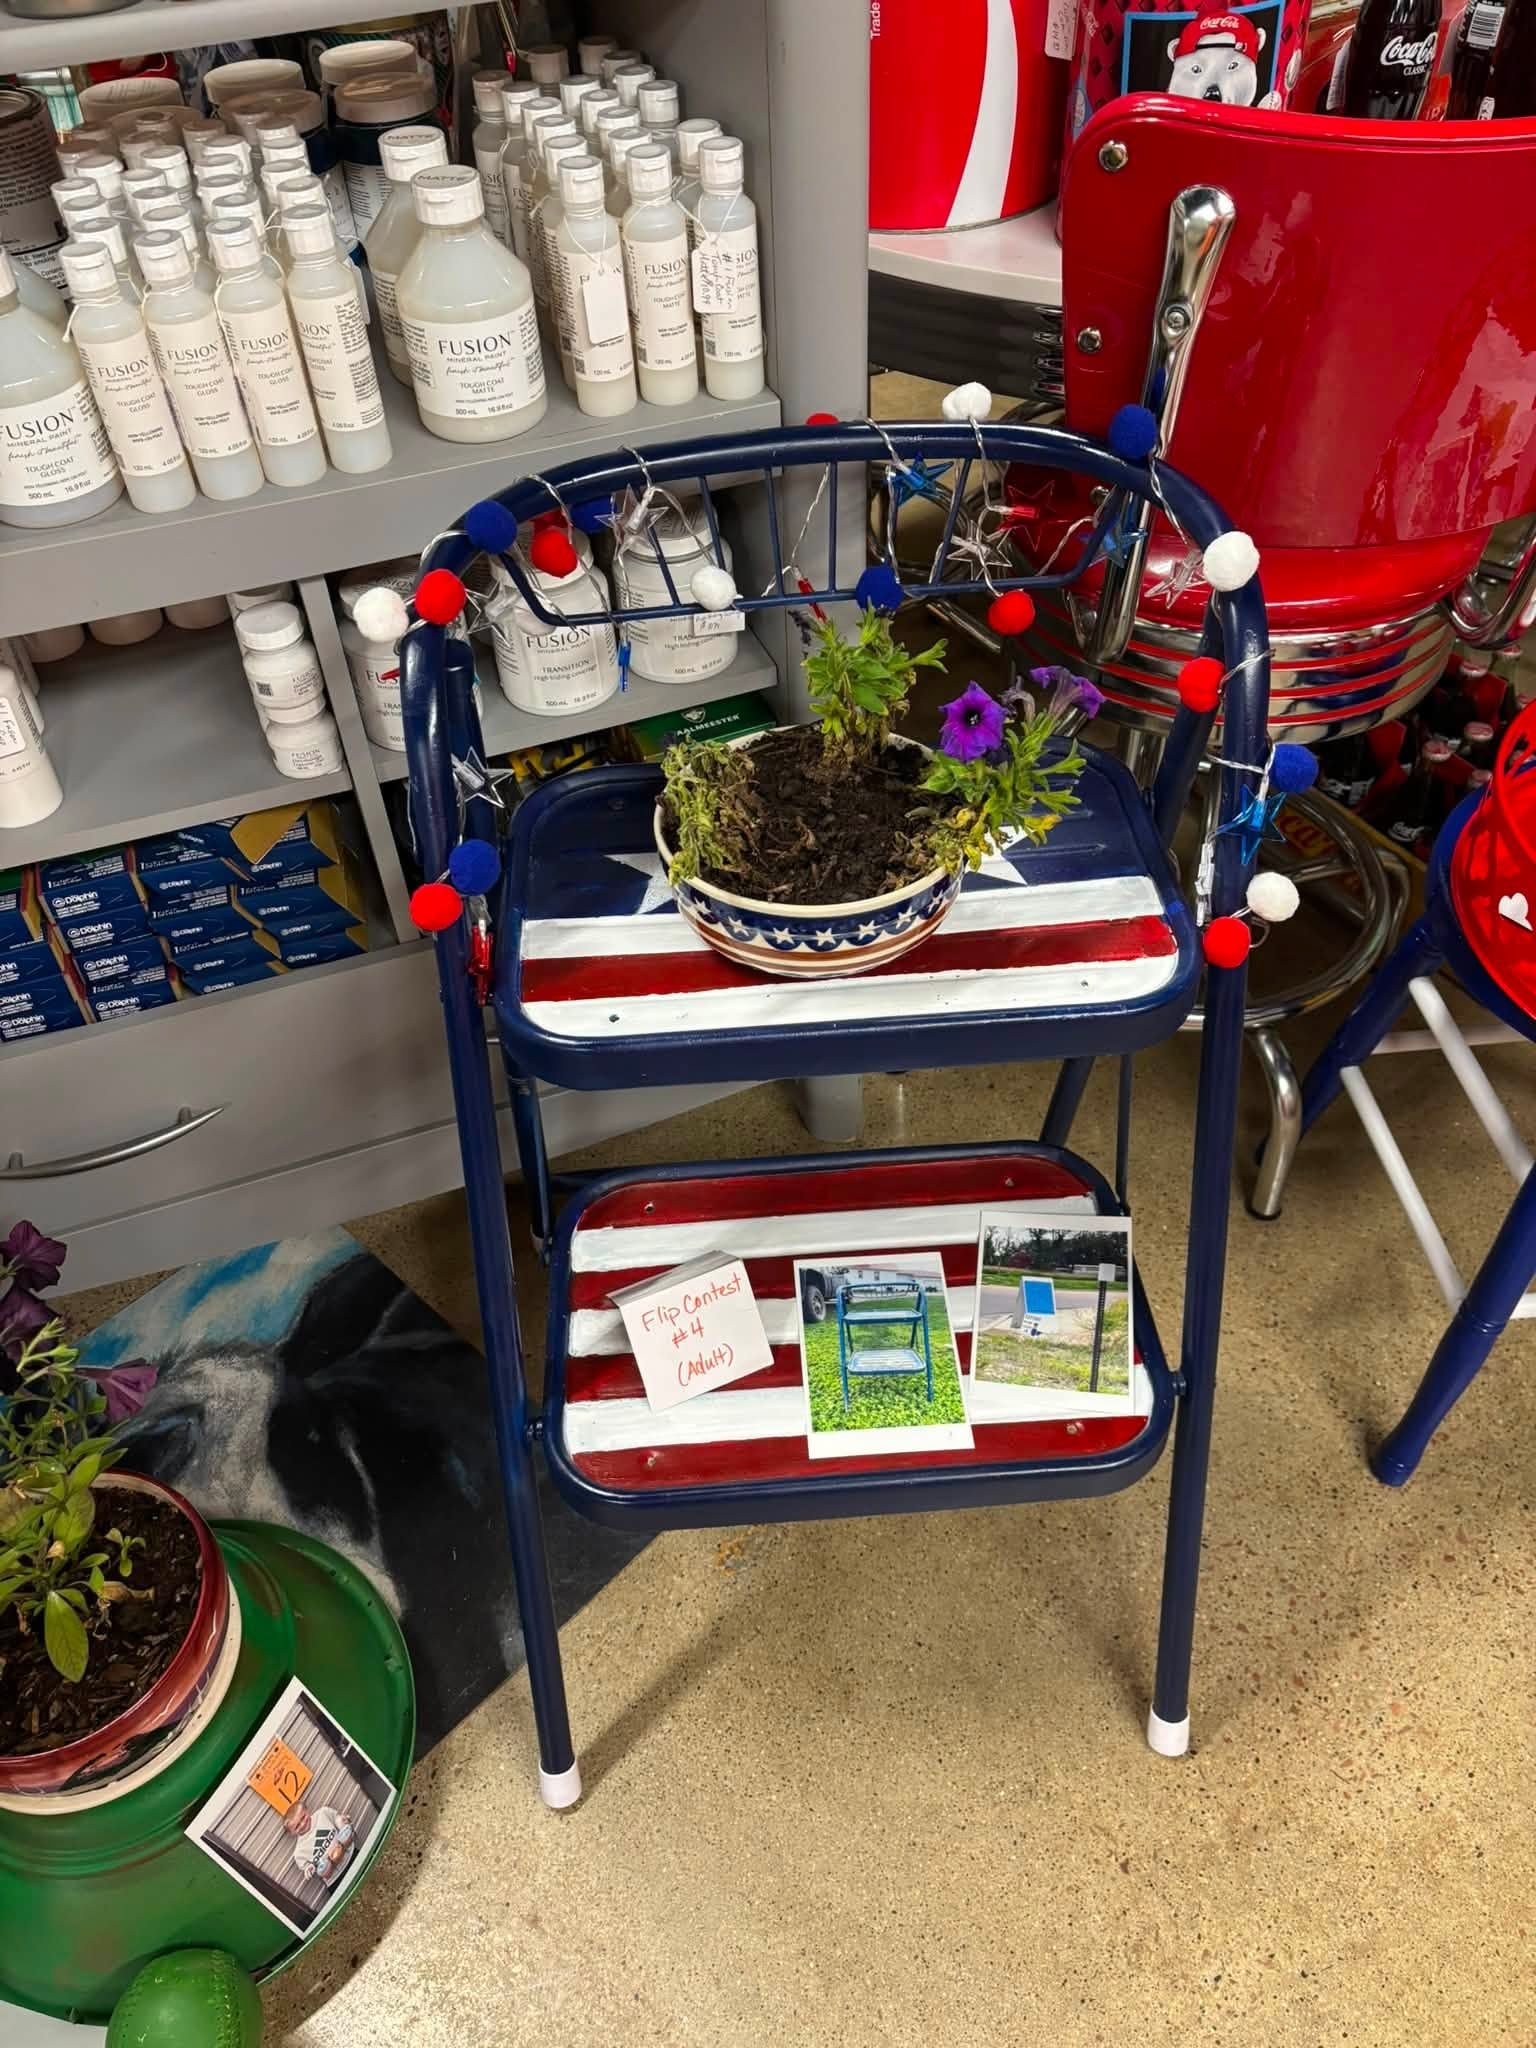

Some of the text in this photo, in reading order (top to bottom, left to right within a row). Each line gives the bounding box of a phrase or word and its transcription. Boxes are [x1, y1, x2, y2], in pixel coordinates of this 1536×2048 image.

[240, 332, 289, 351] FUSION
[438, 332, 512, 356] FUSION
[167, 343, 219, 361] FUSION
[447, 351, 507, 363] MINERAL PAINT
[98, 359, 149, 378] FUSION
[460, 378, 505, 390] TOUGH COAT
[456, 408, 467, 416] 500
[7, 428, 72, 448] MINERAL PAINT
[25, 455, 74, 474] TOUGH COAT
[39, 466, 67, 479] GLOSS
[28, 491, 42, 500] 500
[526, 627, 592, 648] FUSION
[542, 658, 590, 674] TRANSITION
[676, 713, 741, 737] AALMEESTER
[64, 891, 98, 904] Dolphin
[79, 922, 113, 935] Dolphin
[95, 954, 128, 967] Dolphin
[107, 996, 140, 1009] Dolphin
[11, 1015, 45, 1027] Dolphin
[641, 1271, 742, 1332] Flip Contest
[677, 1343, 735, 1387] (Adult)
